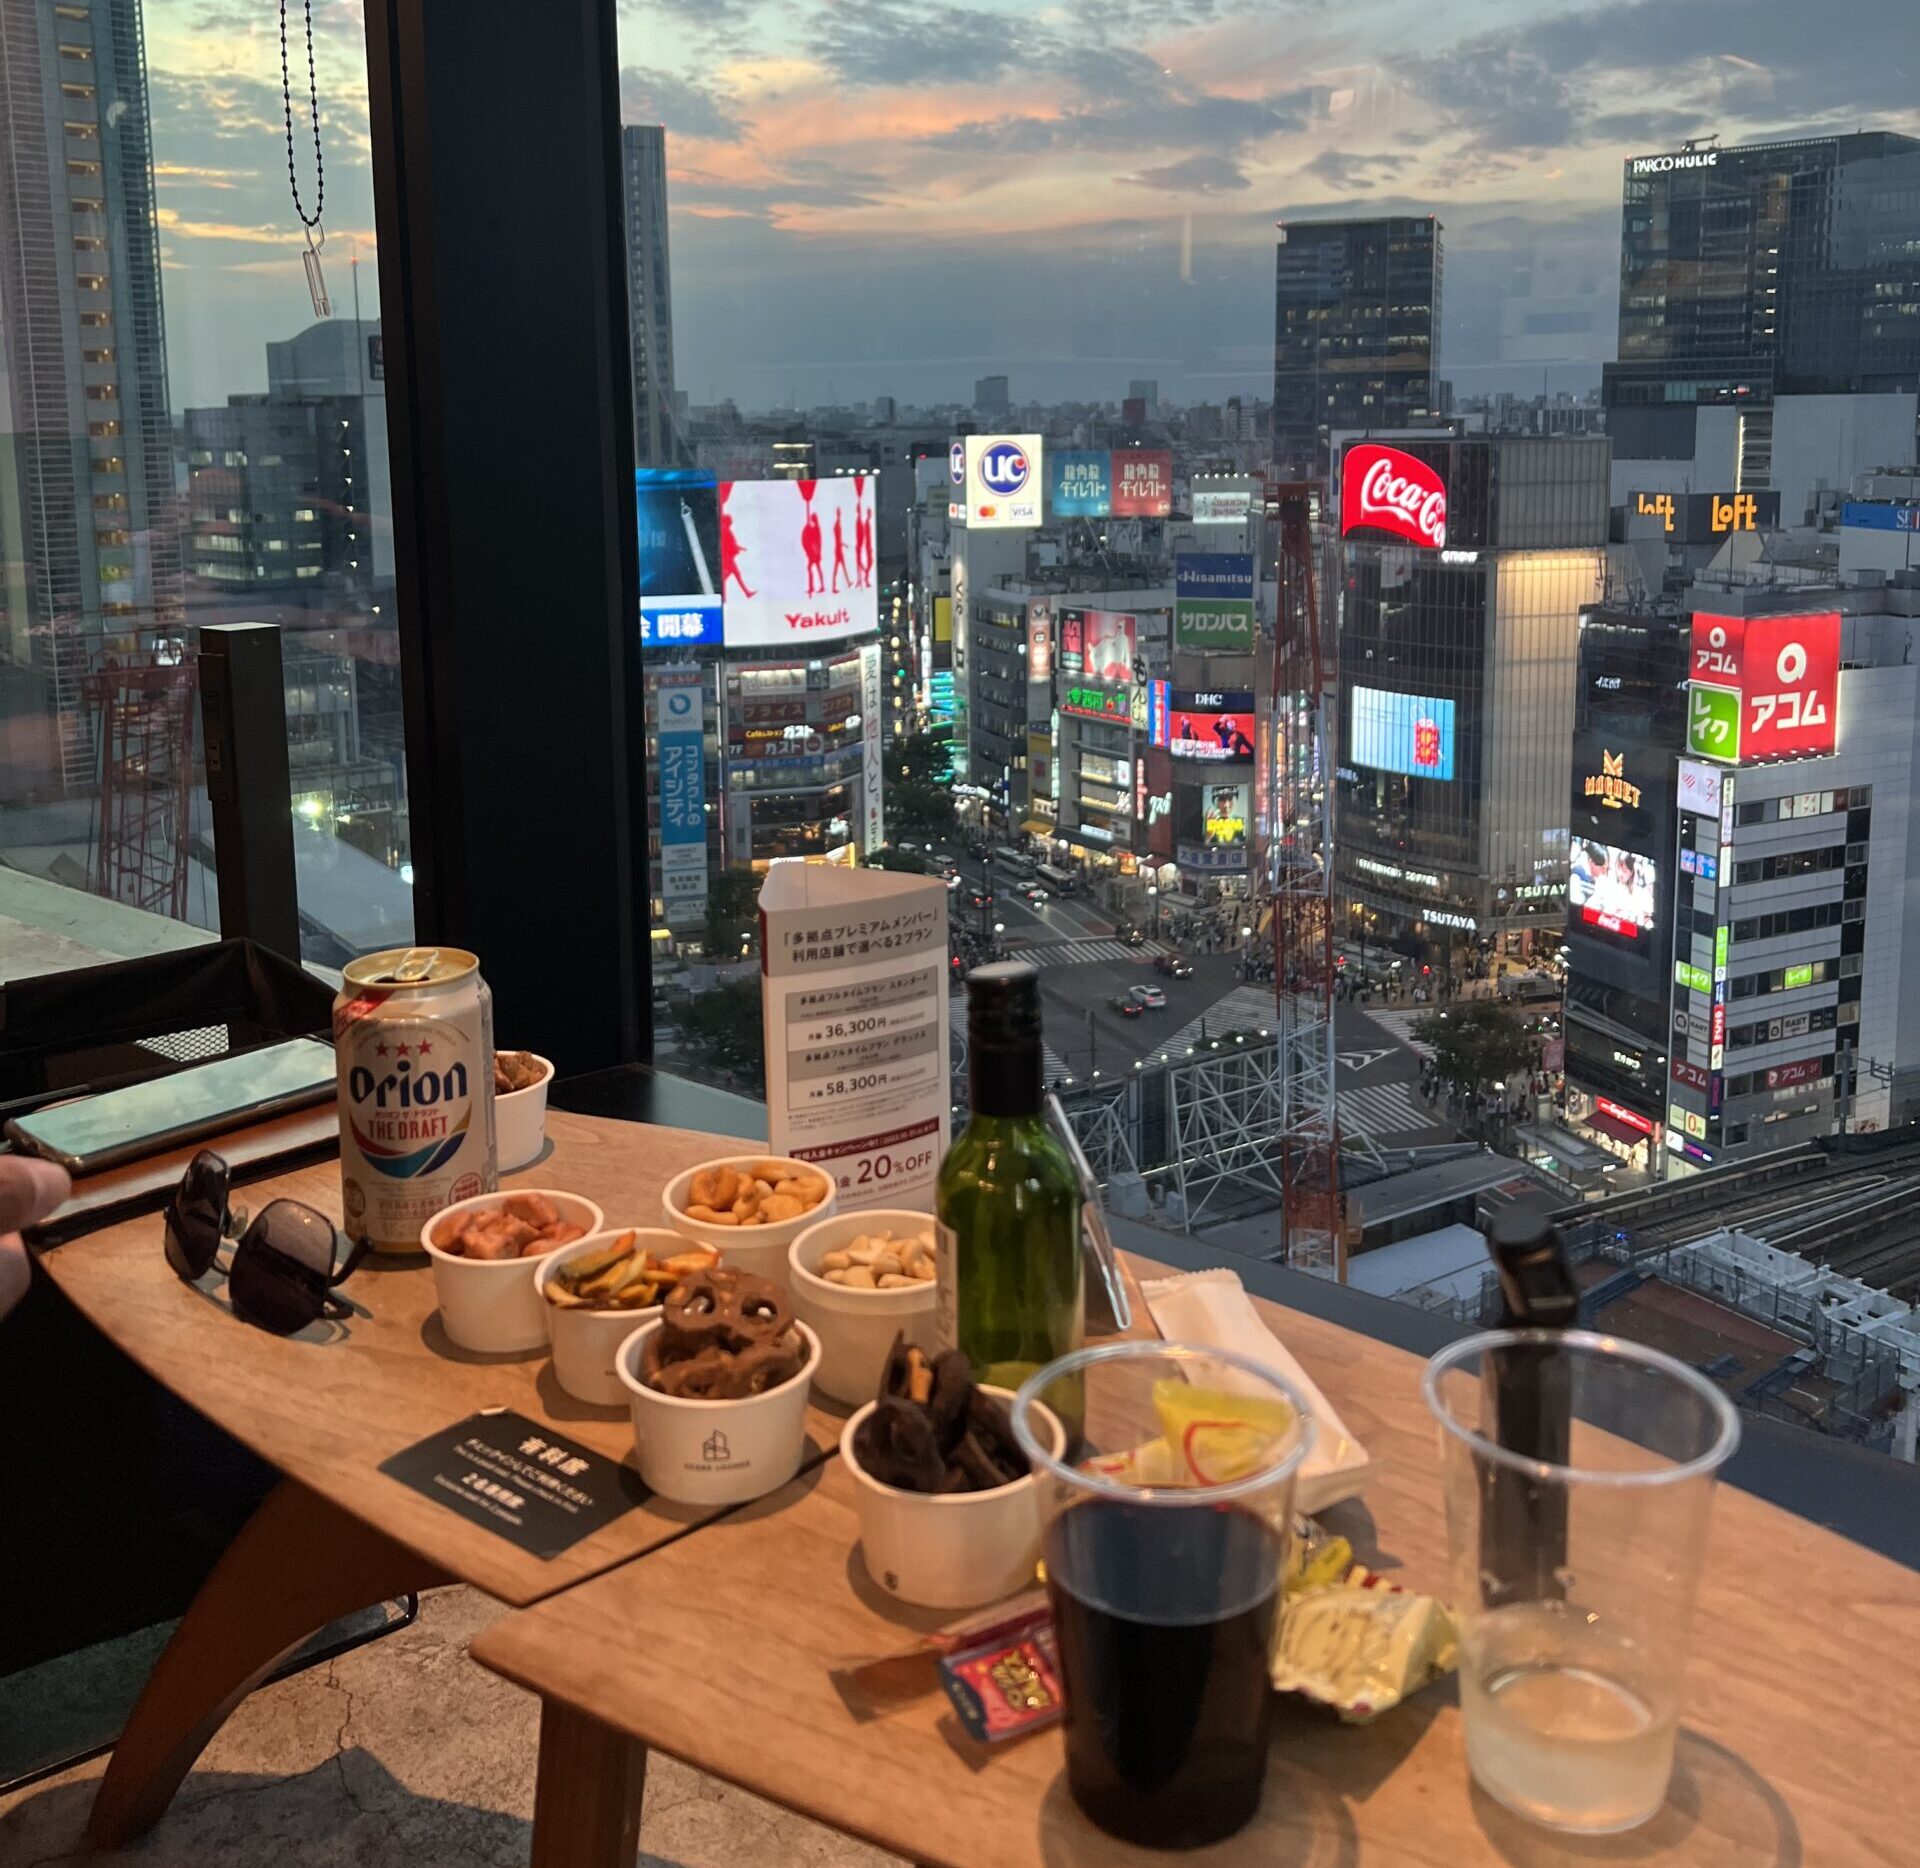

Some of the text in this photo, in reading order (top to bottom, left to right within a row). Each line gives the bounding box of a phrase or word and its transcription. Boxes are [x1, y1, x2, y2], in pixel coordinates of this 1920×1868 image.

[1633, 152, 1717, 173] PARCO HULIC
[784, 609, 850, 629] Yakult
[1181, 612, 1248, 632] サロンパス
[1696, 650, 1737, 675] アコム
[1195, 693, 1223, 706] DHC
[1751, 690, 1827, 733] アコム
[664, 746, 684, 827] アイシティ
[1422, 909, 1476, 930] TSUTAYA
[792, 929, 933, 962] 利用店舗で選べる2プラン
[825, 1016, 887, 1038] 36,300円
[350, 1060, 468, 1107] Orion
[826, 1074, 888, 1095] 58,300円
[1677, 1063, 1706, 1087] アコム
[368, 1115, 449, 1140] THE DRAFT
